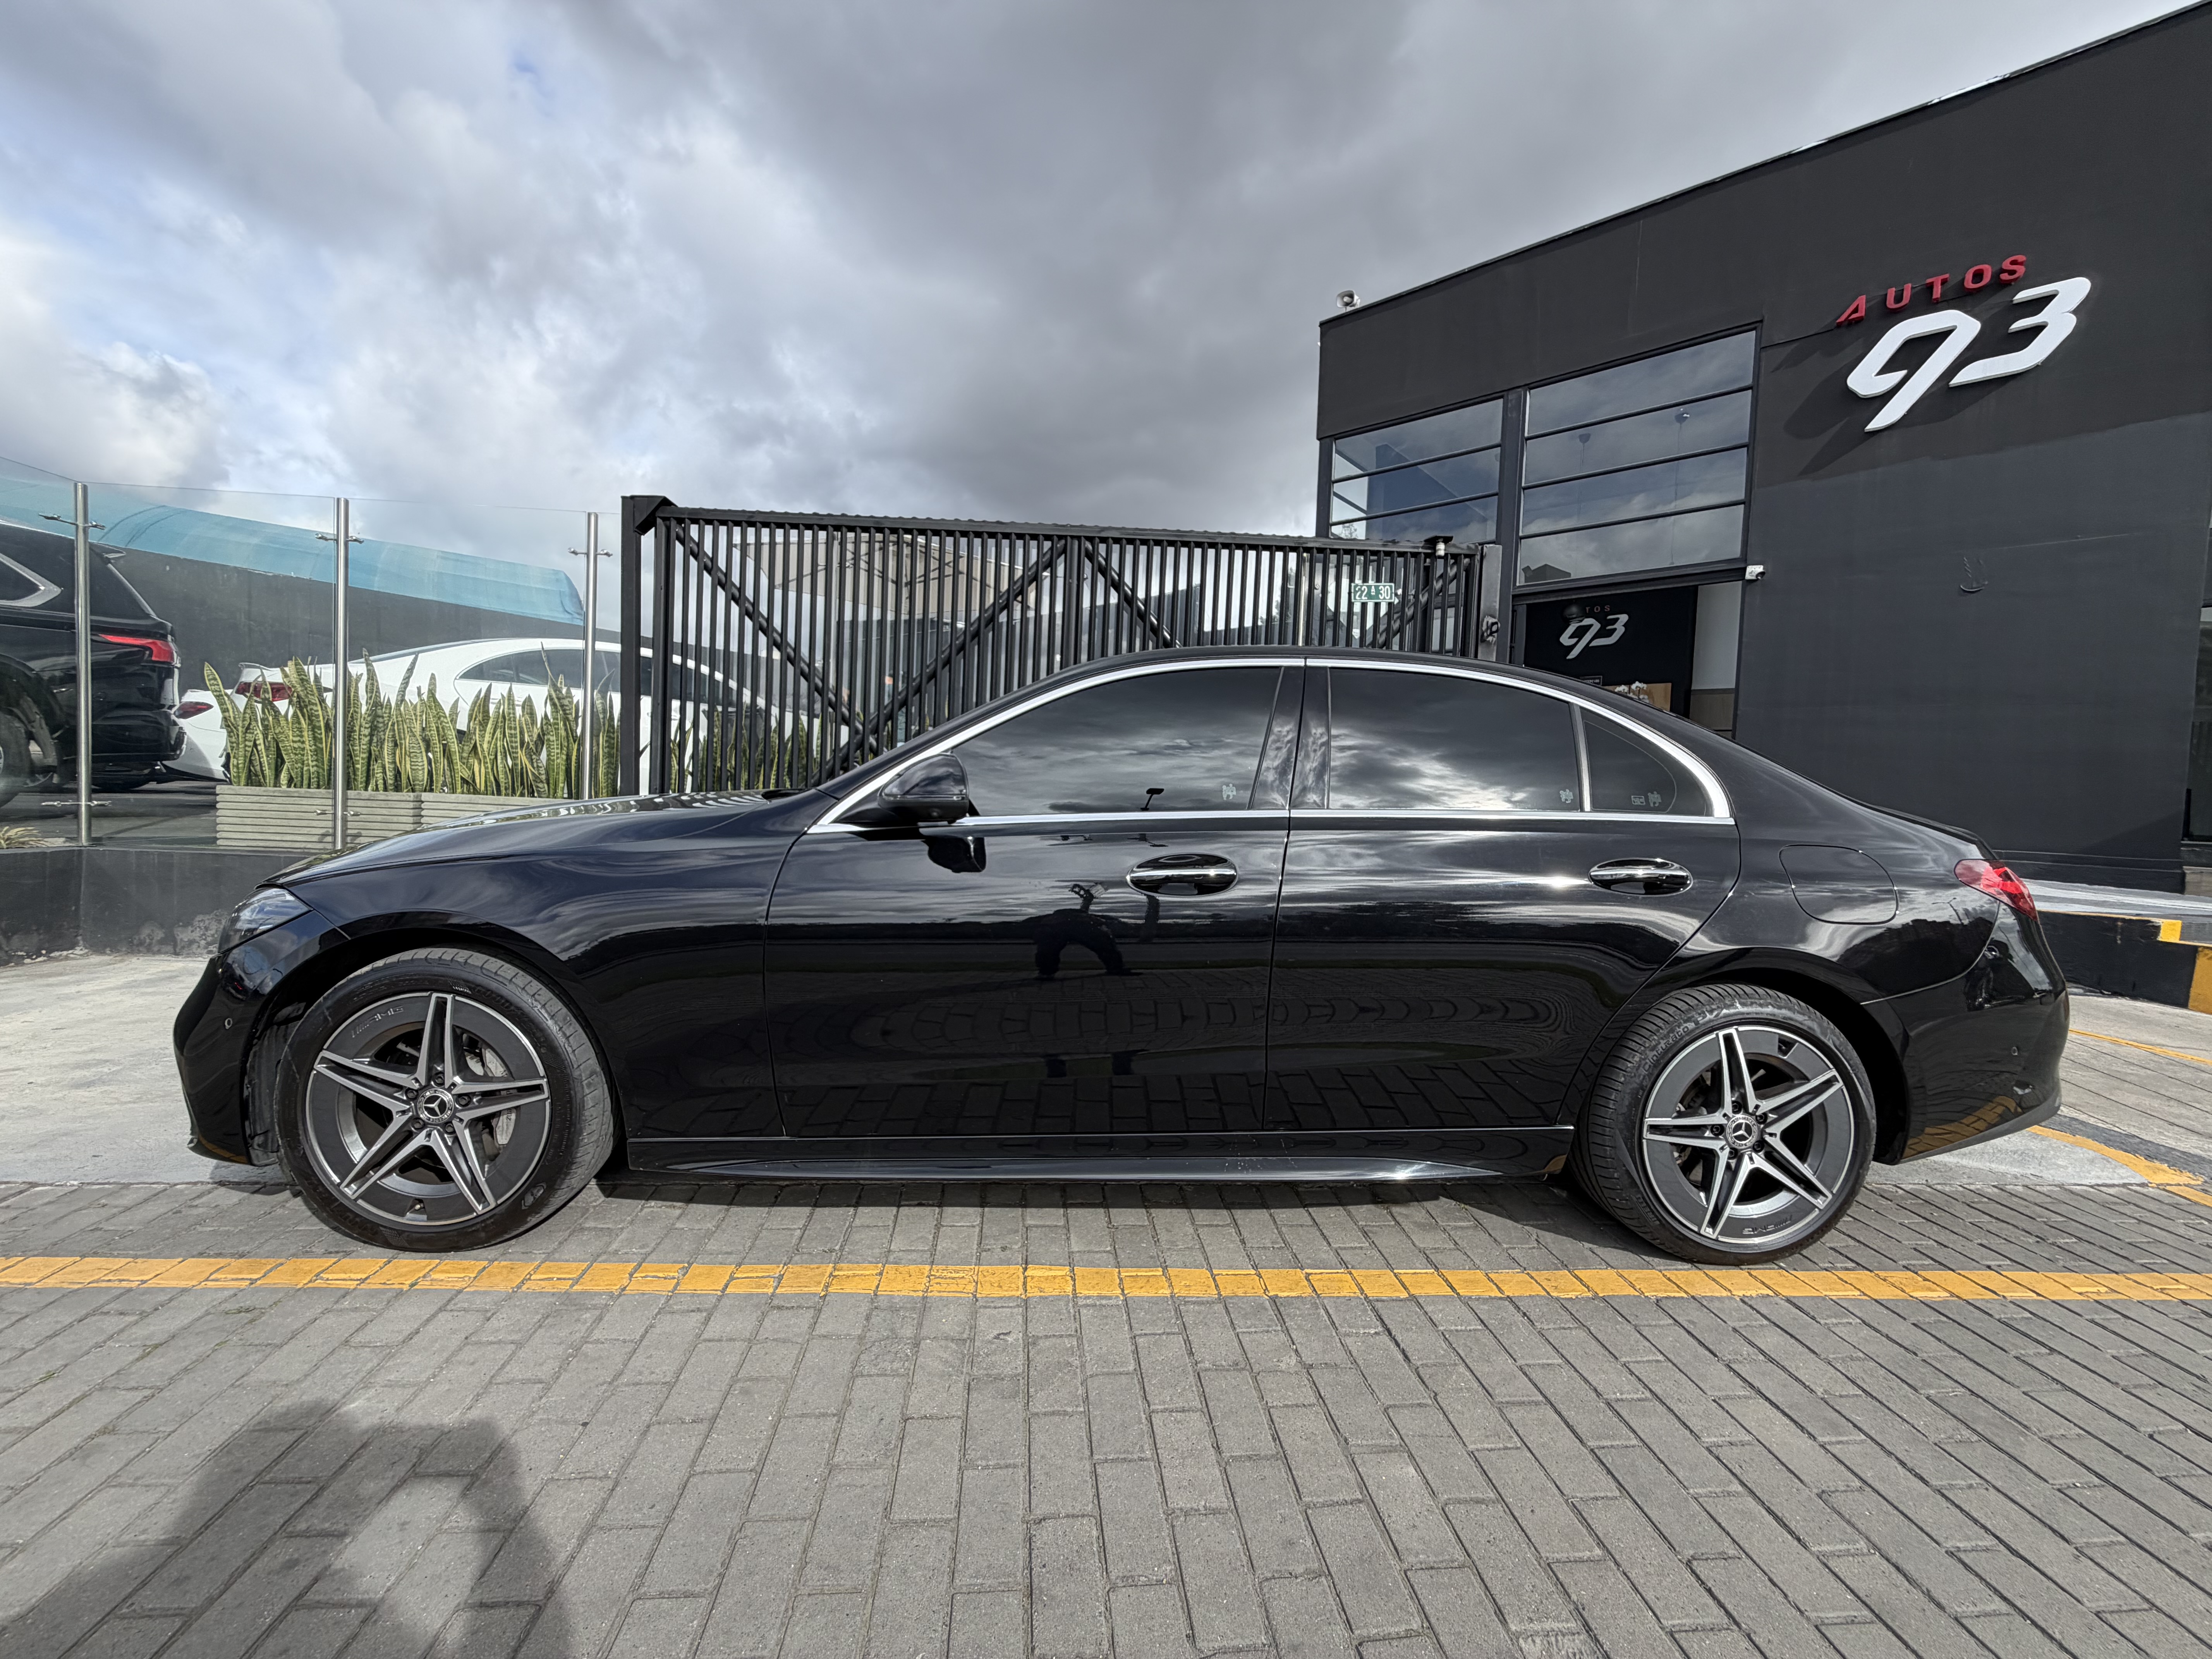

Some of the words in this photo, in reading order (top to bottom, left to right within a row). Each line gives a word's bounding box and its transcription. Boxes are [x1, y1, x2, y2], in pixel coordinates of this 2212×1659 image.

[1836, 255, 2027, 326] AUTOS
[1847, 277, 2091, 432] 93
[1356, 586, 1367, 599] 22
[1379, 586, 1390, 599] 30
[1559, 614, 1629, 659] 93
